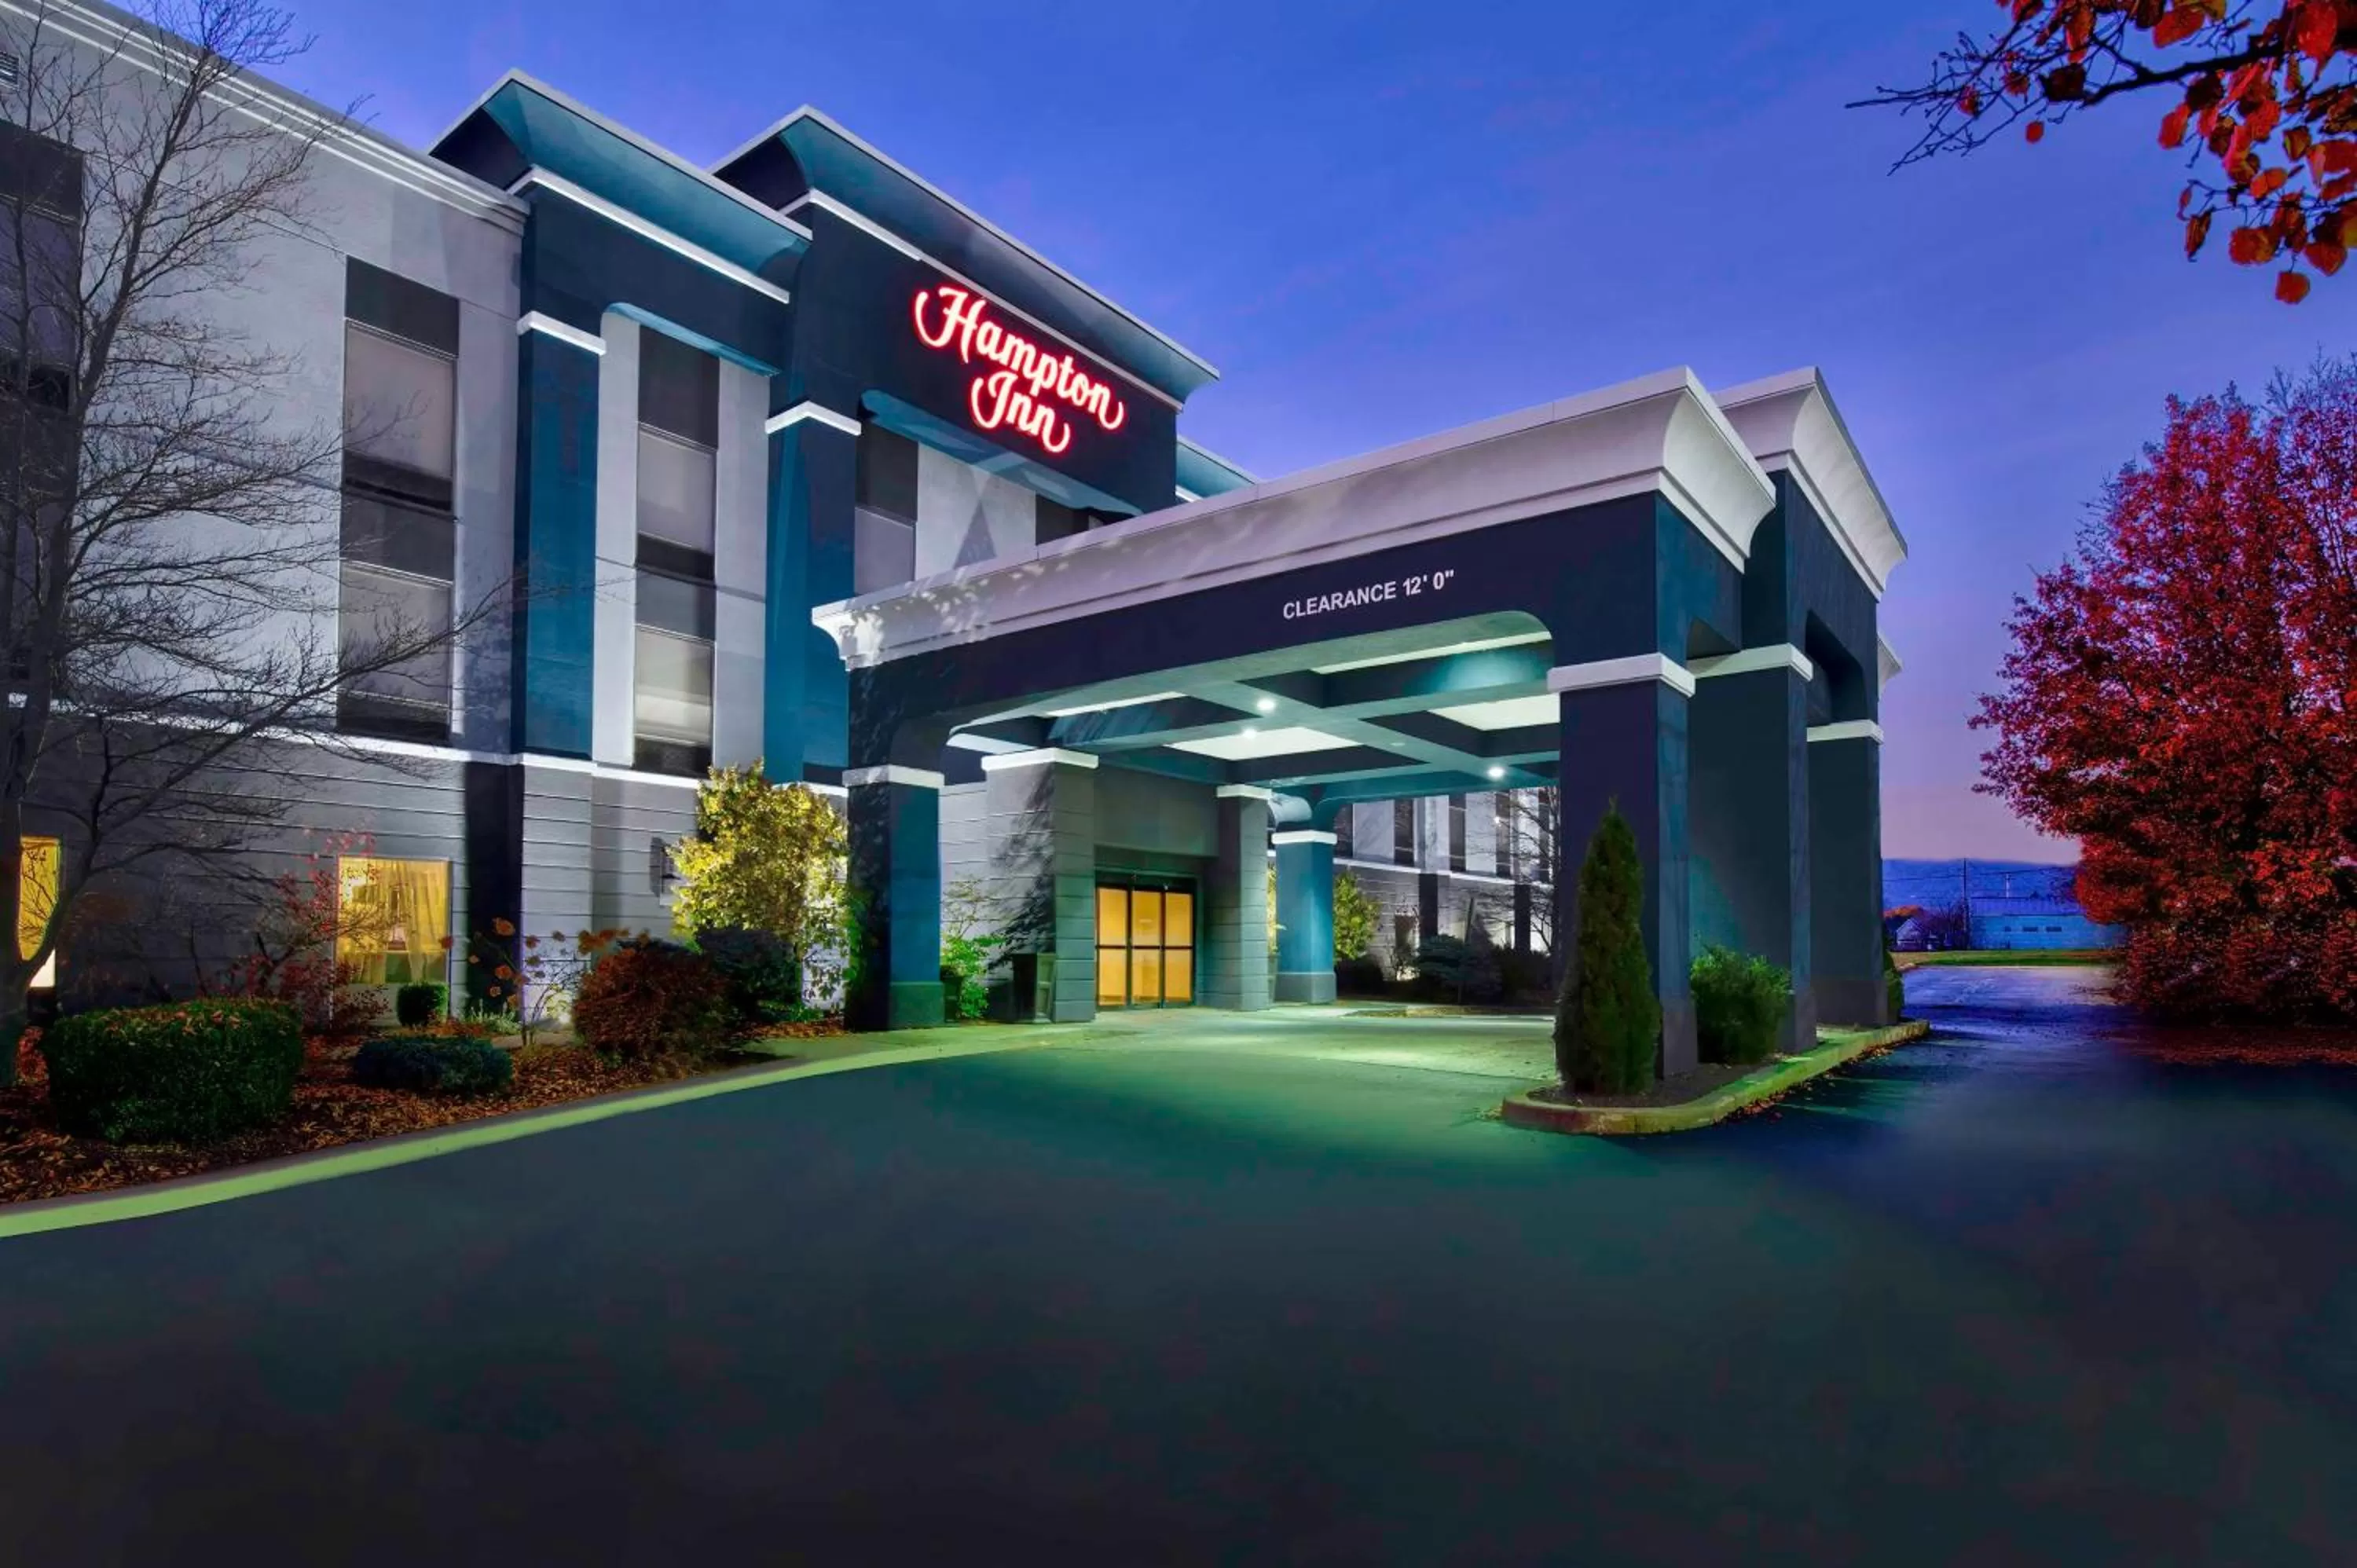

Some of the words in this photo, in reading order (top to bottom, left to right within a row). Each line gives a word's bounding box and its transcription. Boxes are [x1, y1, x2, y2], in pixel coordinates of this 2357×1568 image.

[915, 287, 1124, 430] Hampton
[971, 371, 1070, 452] Inn
[1283, 581, 1396, 619] CLEARANCE
